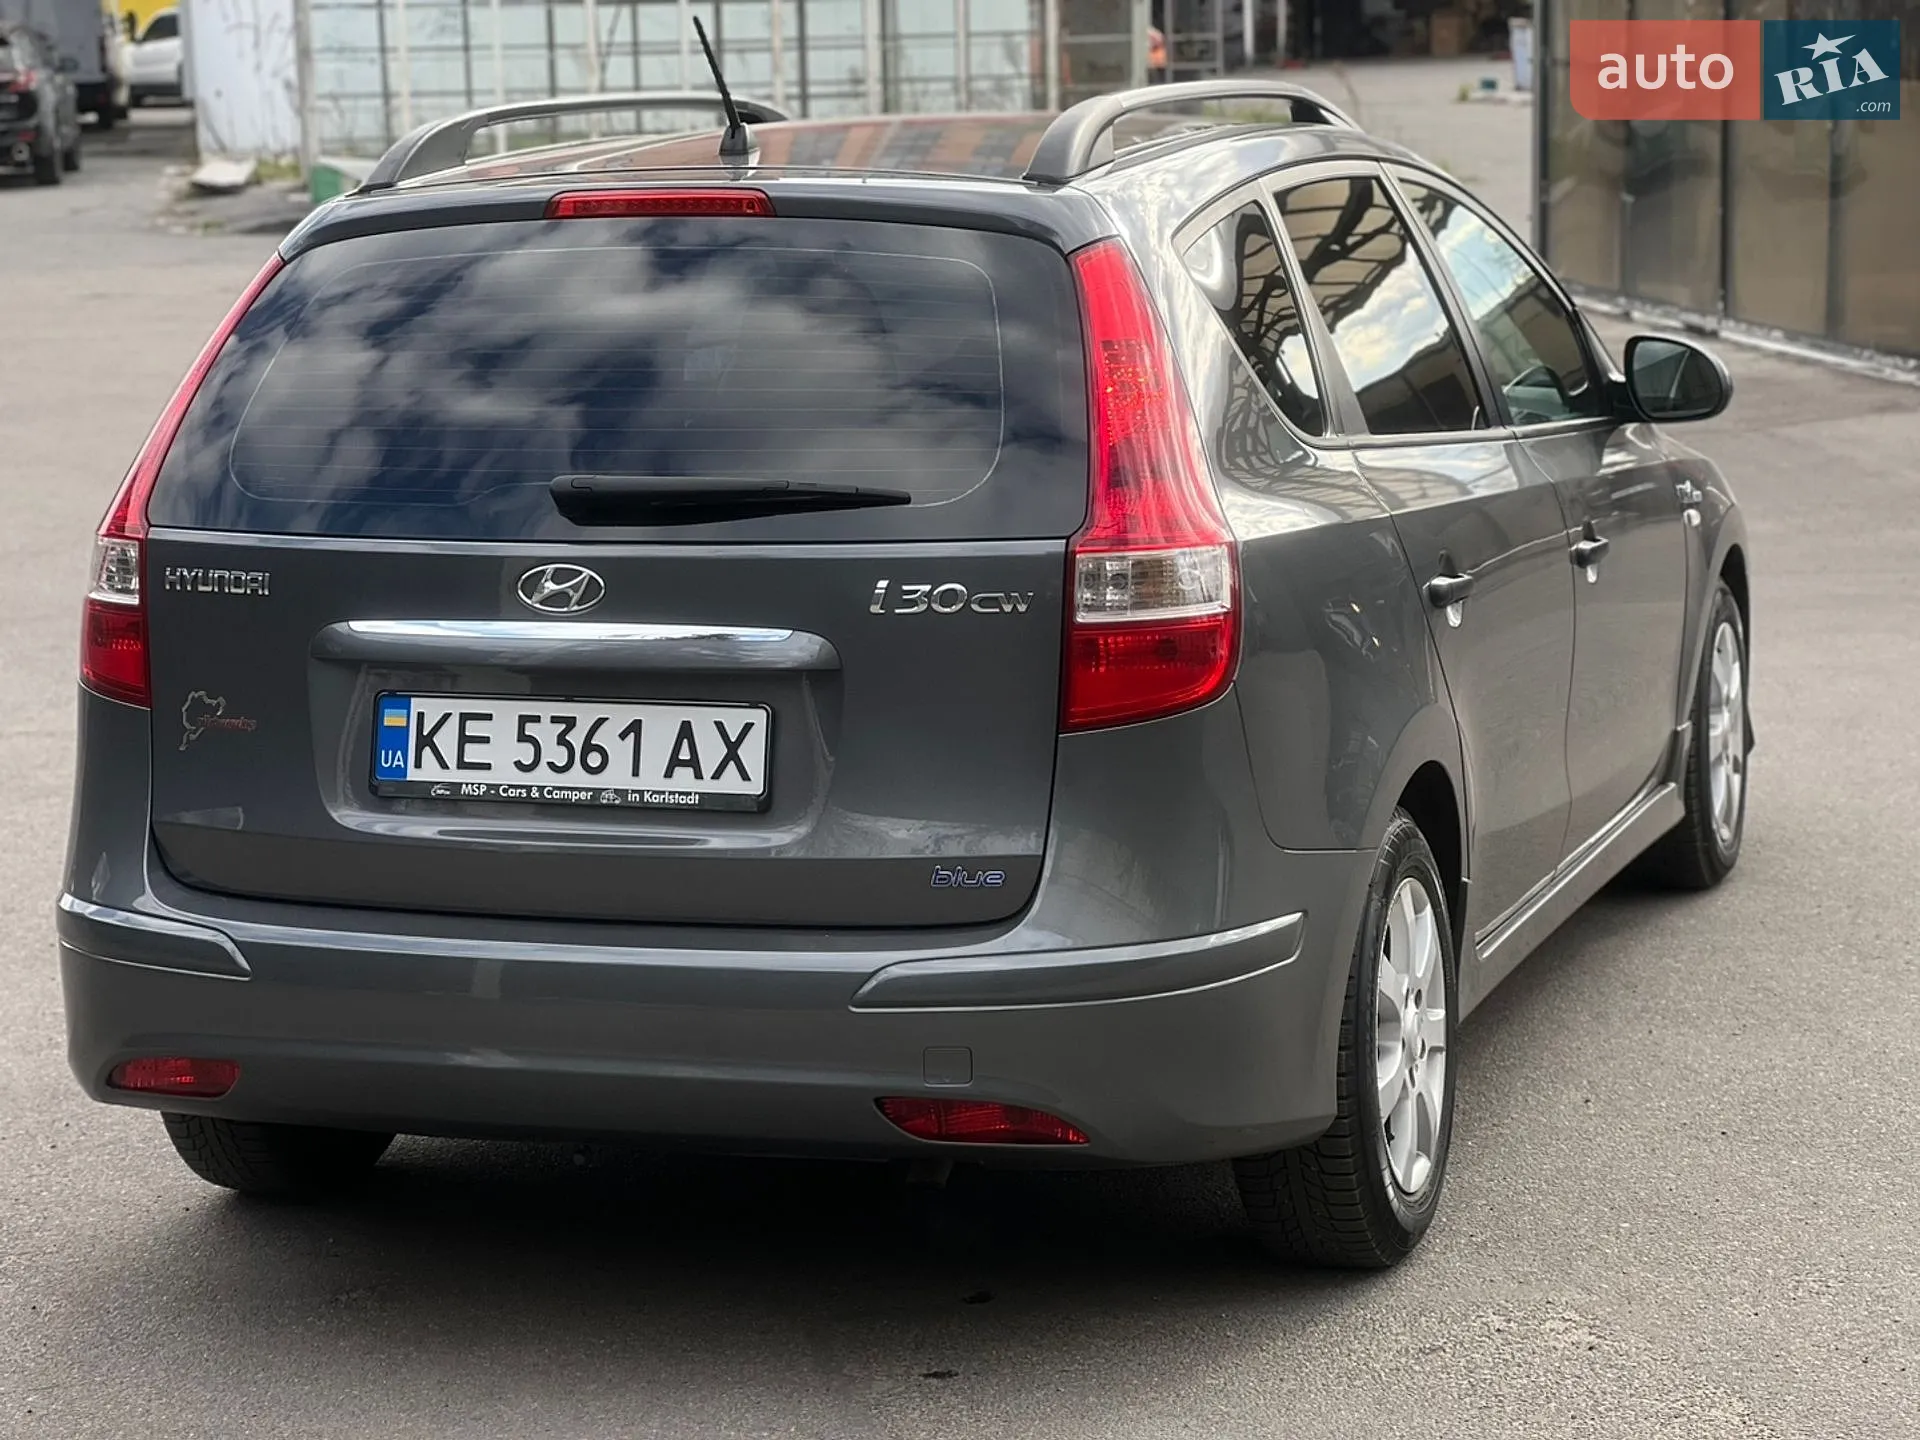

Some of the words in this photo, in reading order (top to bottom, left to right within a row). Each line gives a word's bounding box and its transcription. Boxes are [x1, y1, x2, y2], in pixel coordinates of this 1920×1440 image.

[164, 567, 270, 595] HYUNDAI
[413, 711, 494, 771] KE
[513, 714, 643, 778] 5361
[663, 720, 755, 782] AX
[381, 750, 405, 769] UA
[461, 783, 487, 796] MSP
[499, 785, 527, 797] Cars
[530, 786, 540, 798] &
[543, 786, 593, 802] Camper
[627, 789, 640, 802] in
[643, 790, 699, 804] Karlstadt
[930, 865, 1005, 887] blue
